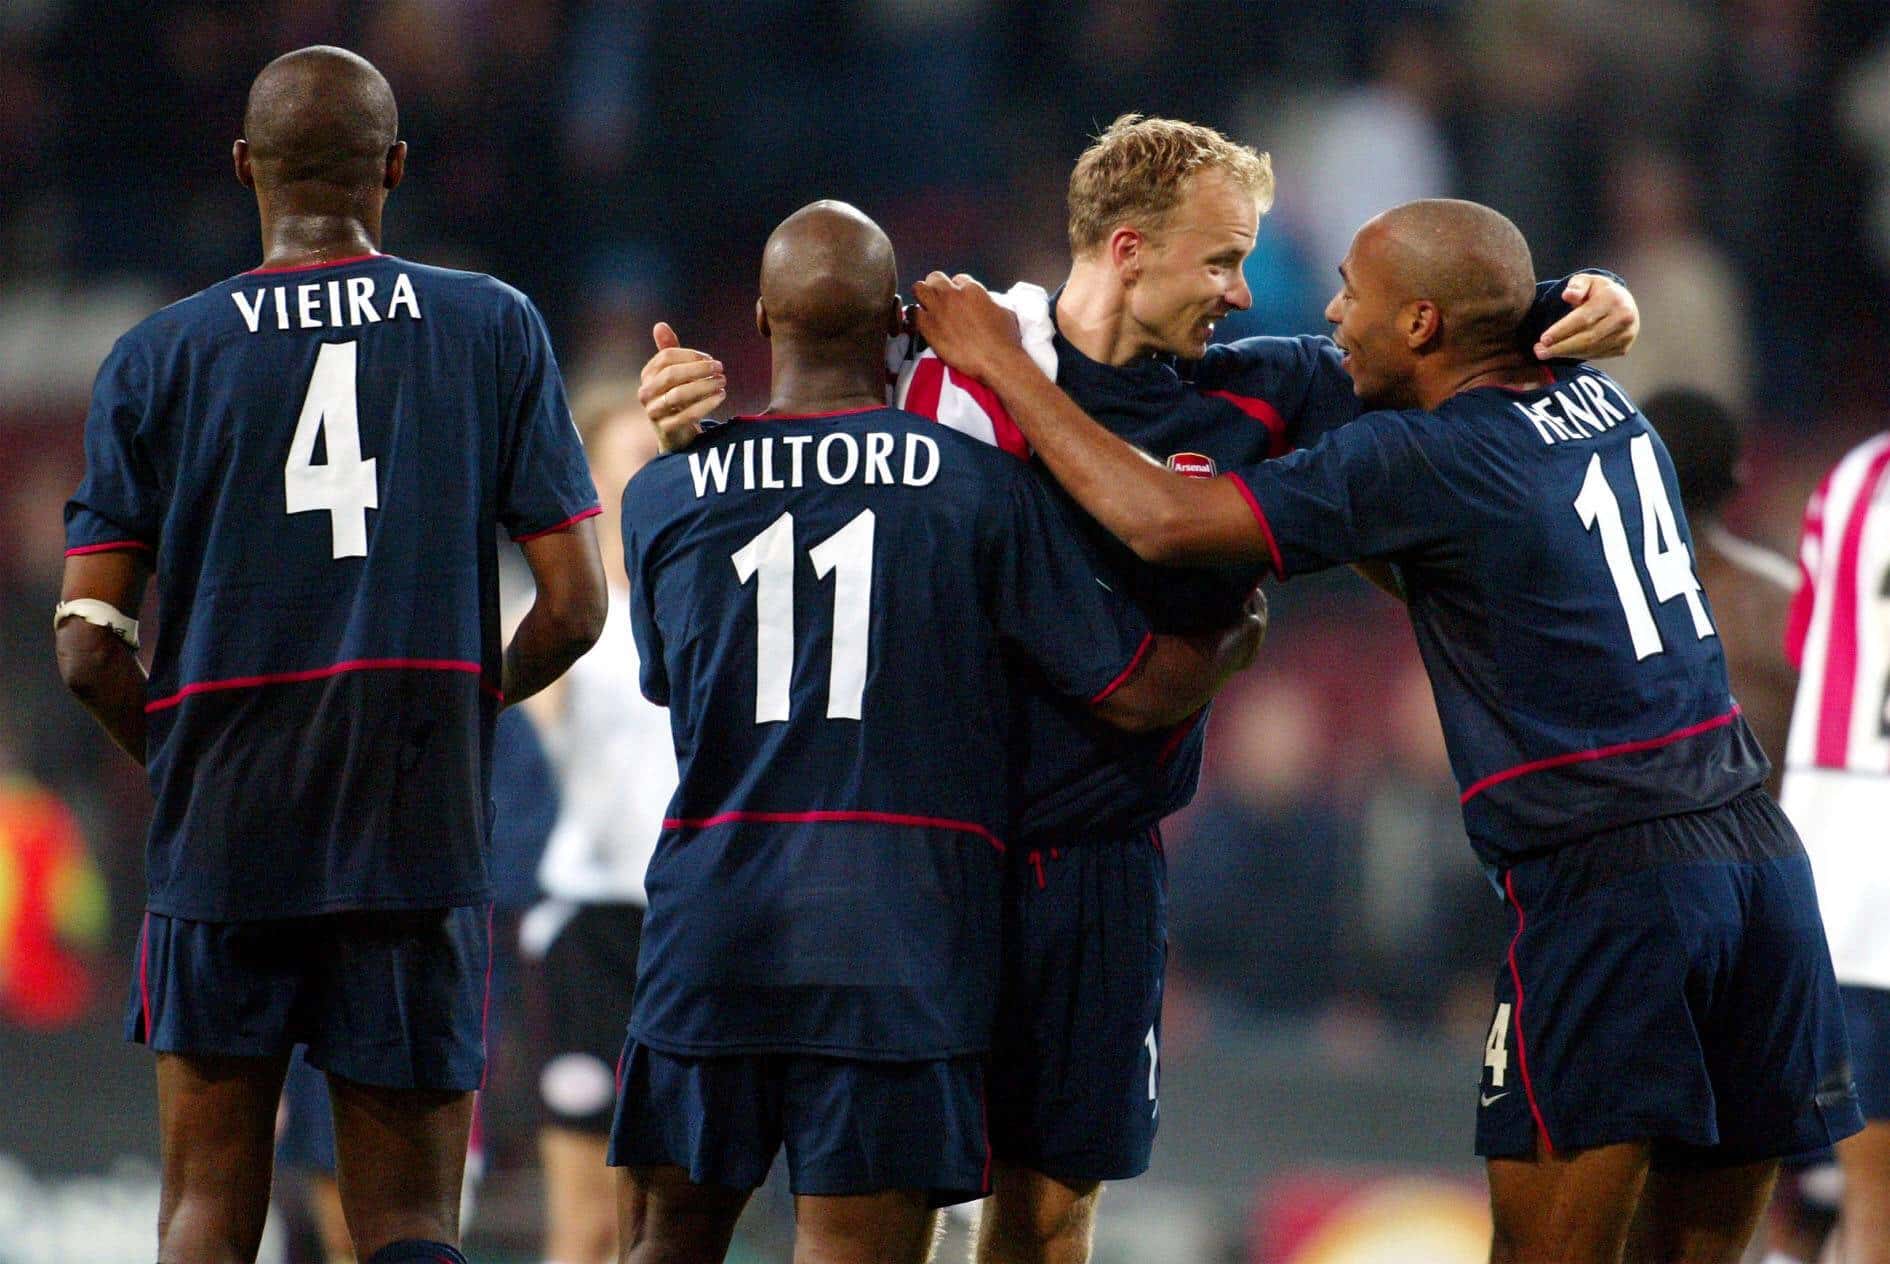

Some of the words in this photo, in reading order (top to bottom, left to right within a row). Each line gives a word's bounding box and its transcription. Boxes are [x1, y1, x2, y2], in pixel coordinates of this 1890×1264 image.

[231, 273, 423, 333] VIEIRA
[284, 340, 378, 560] 4
[687, 431, 941, 498] WILTORD
[1174, 462, 1211, 473] Arsenal
[730, 507, 876, 724] 11
[1573, 431, 1715, 662] 14
